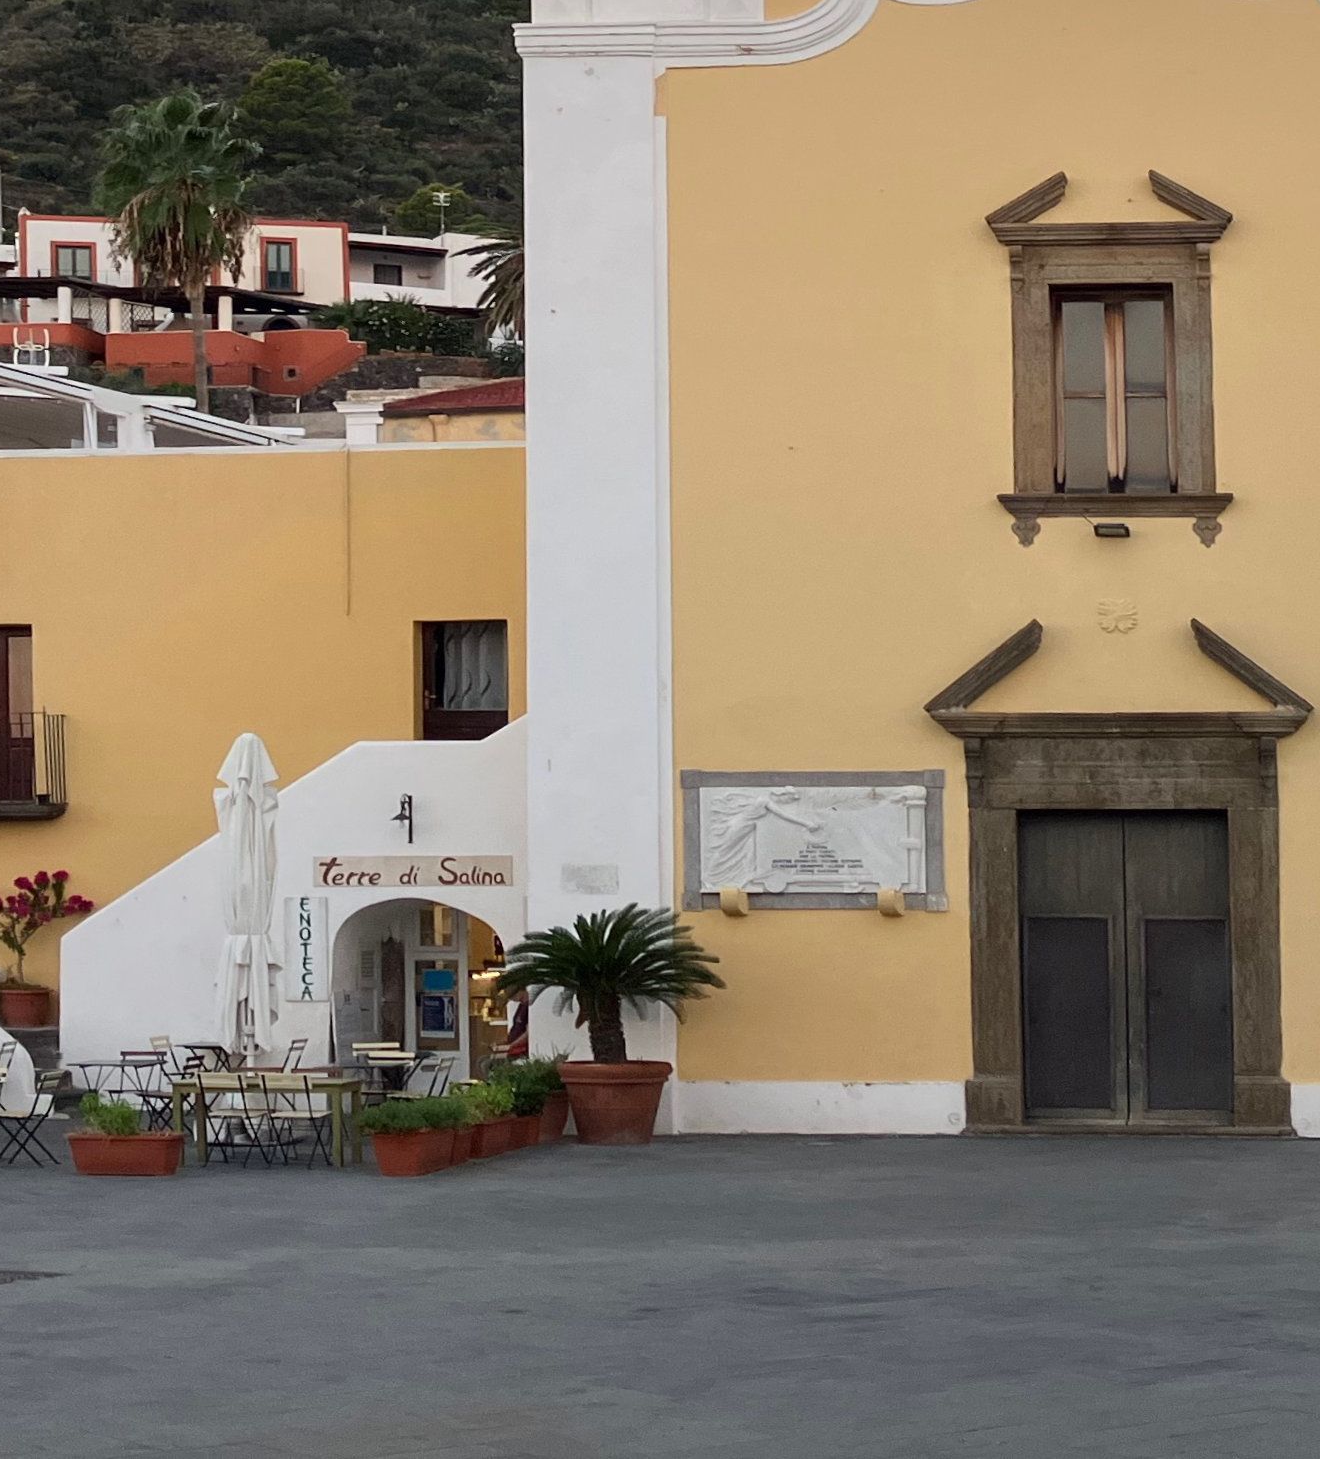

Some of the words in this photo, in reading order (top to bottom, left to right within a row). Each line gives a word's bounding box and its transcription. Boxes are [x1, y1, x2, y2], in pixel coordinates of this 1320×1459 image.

[399, 865, 420, 885] di
[438, 857, 506, 886] Salina
[299, 897, 314, 1001] ENOTECA
